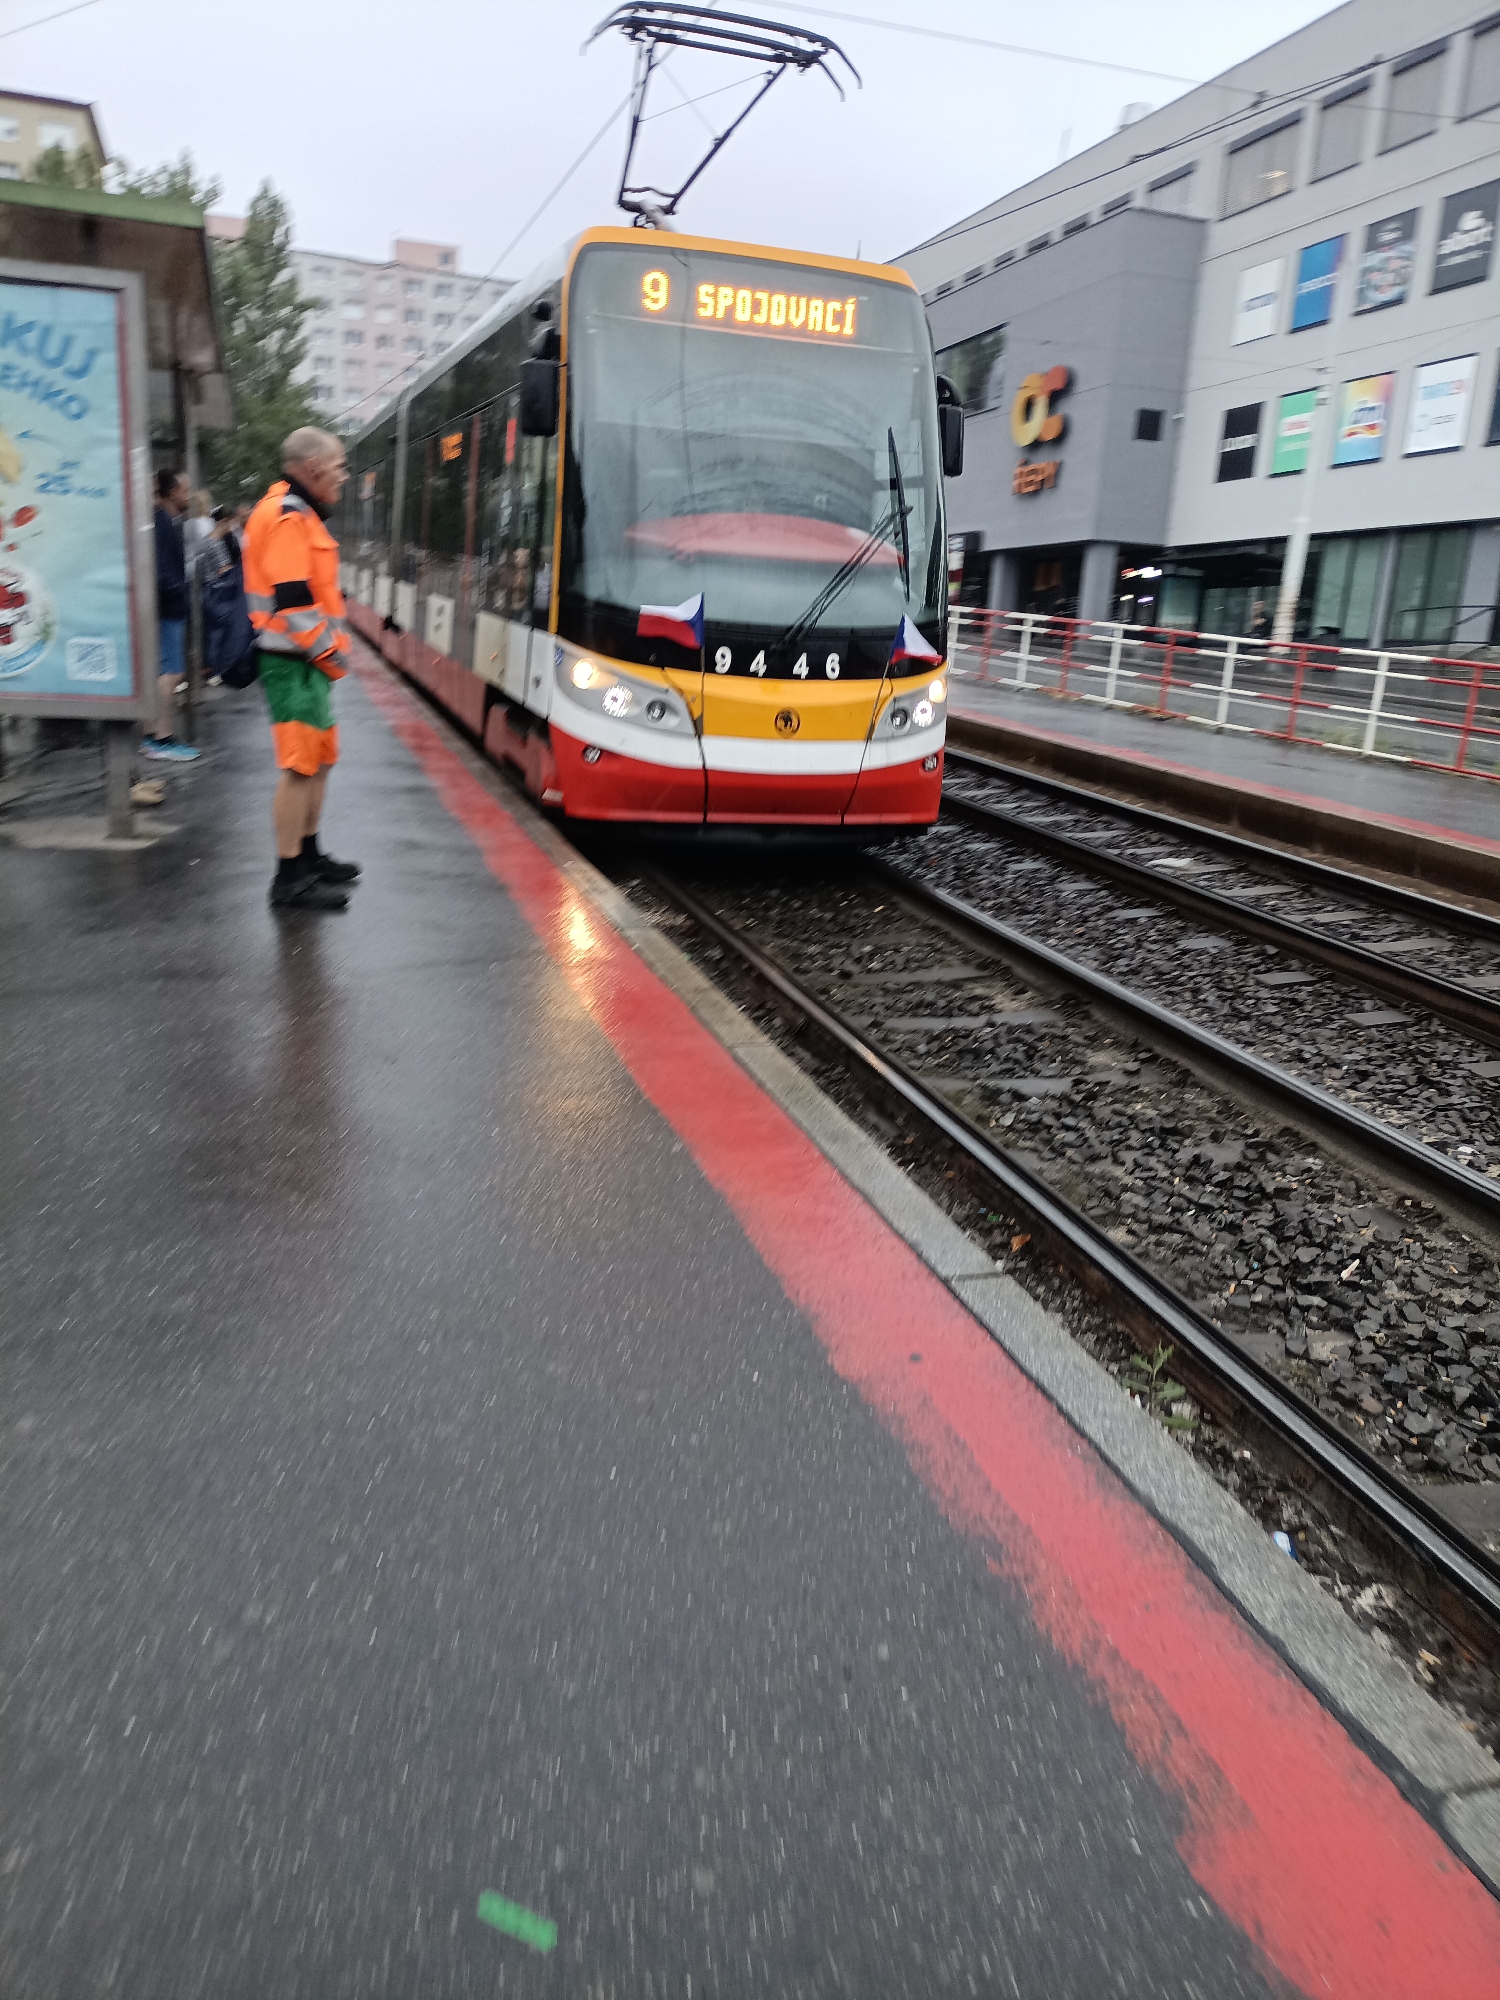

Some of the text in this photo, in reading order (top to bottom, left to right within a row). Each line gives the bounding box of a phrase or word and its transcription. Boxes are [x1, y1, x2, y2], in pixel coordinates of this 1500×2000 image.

[641, 270, 858, 335] 9 SPOJOVACÍ
[714, 645, 841, 680] 9446
